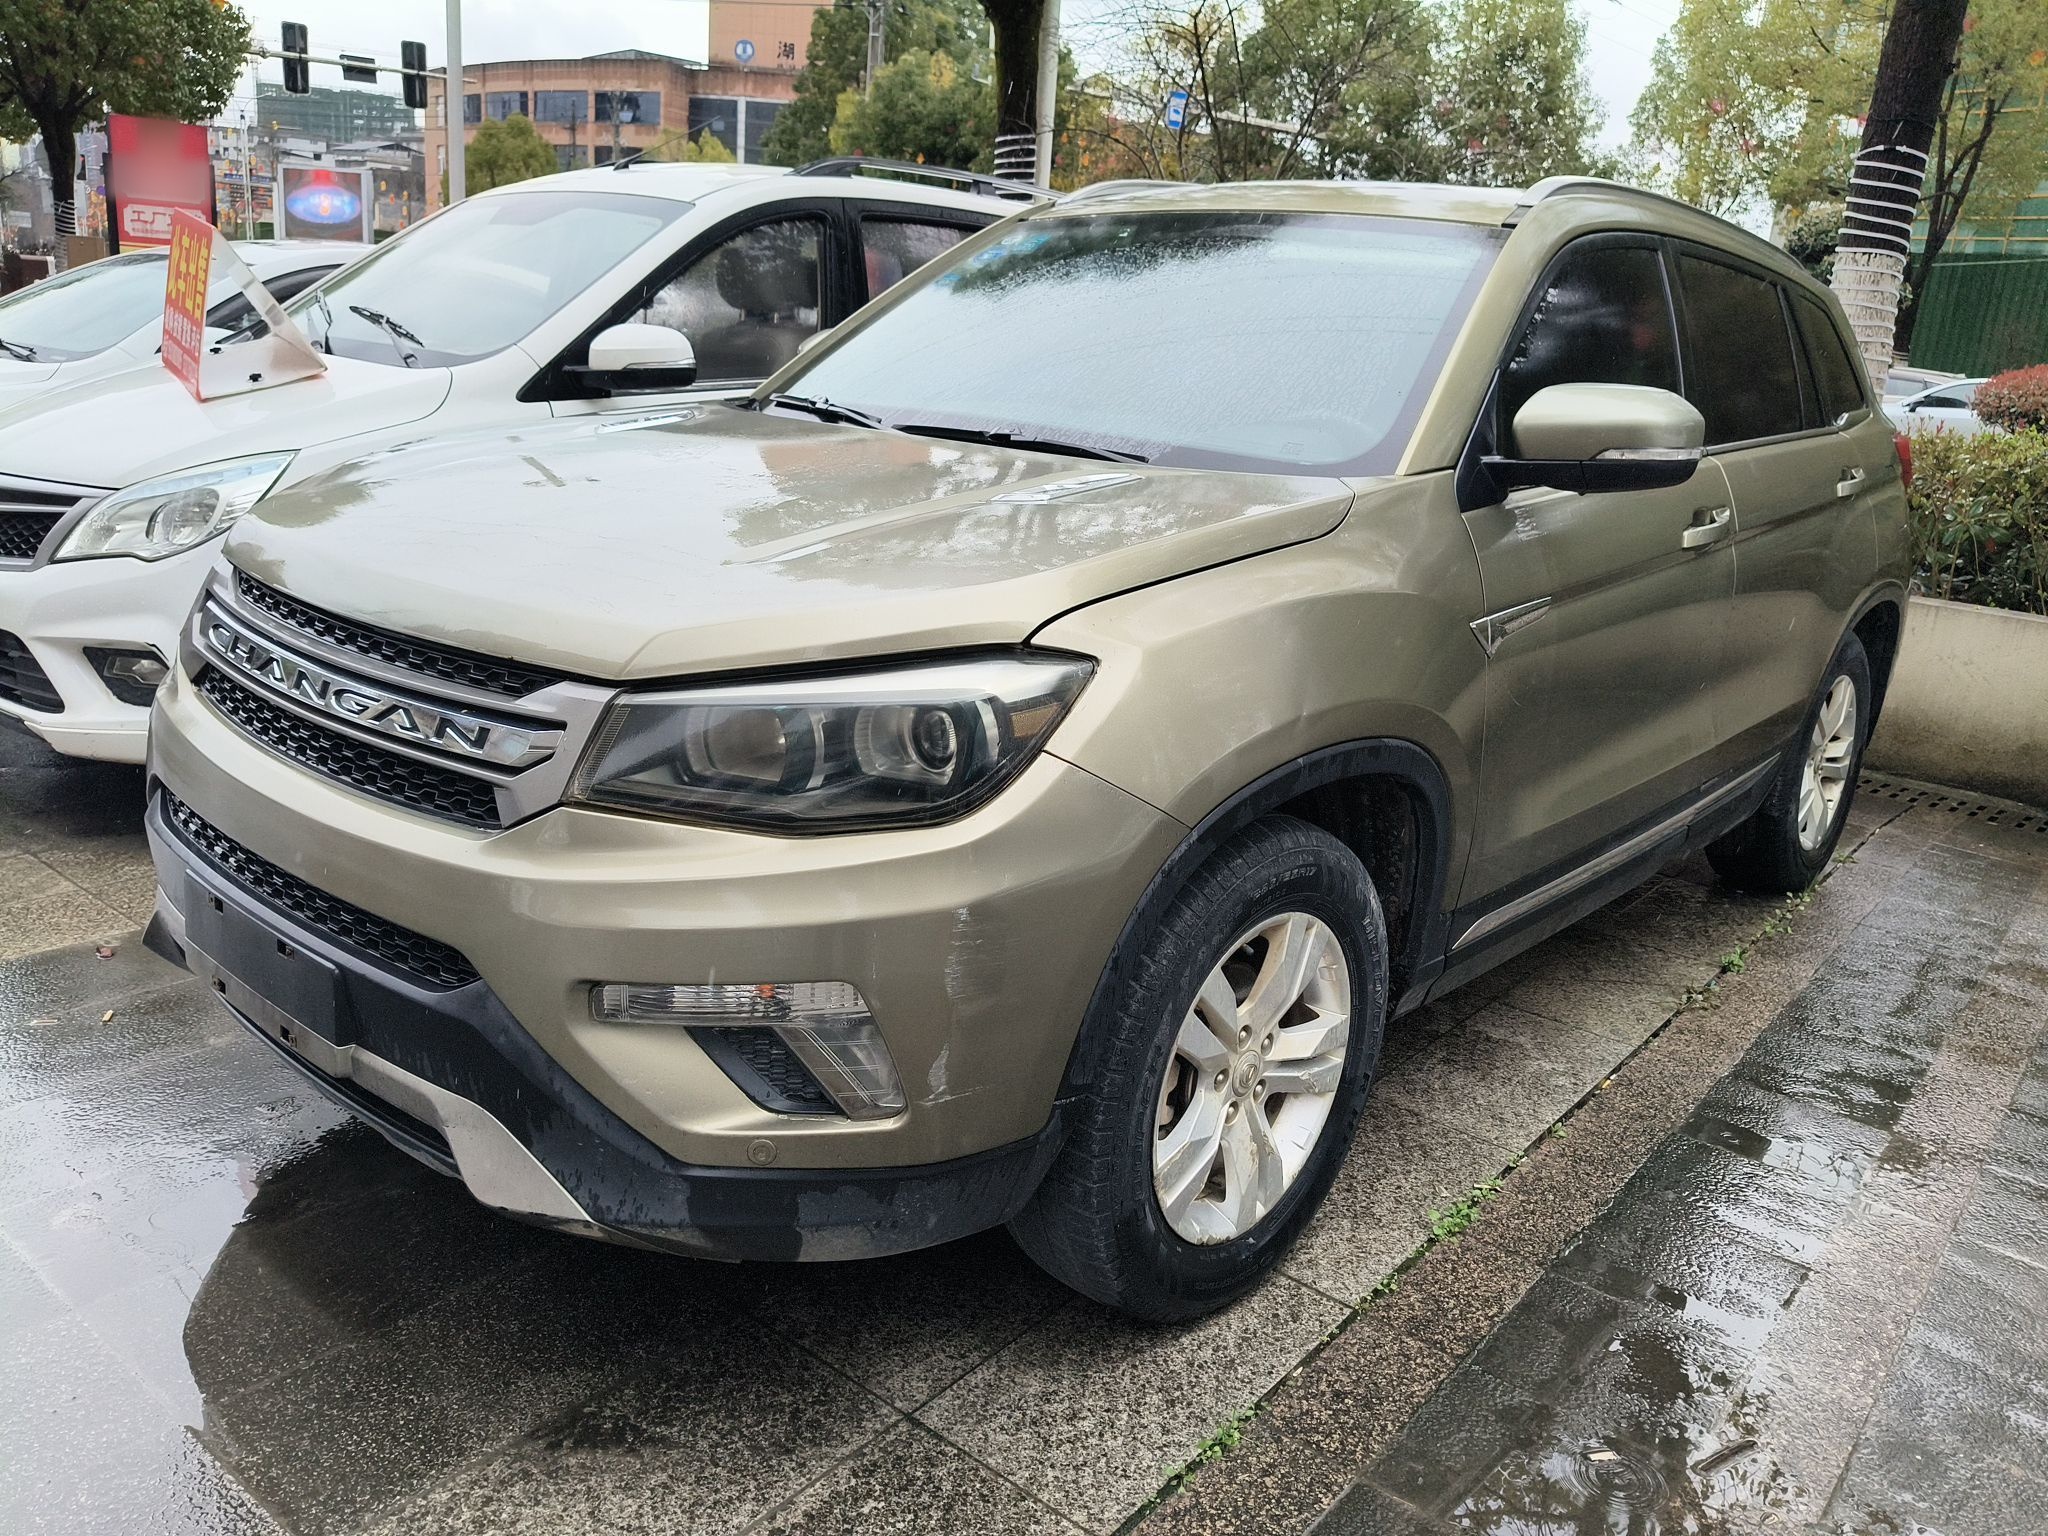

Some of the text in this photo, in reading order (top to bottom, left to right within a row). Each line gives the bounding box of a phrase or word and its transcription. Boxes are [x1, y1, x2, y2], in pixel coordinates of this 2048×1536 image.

[777, 40, 796, 61] 湖
[167, 223, 209, 323] 此车出售
[207, 622, 491, 755] CHANGAN
